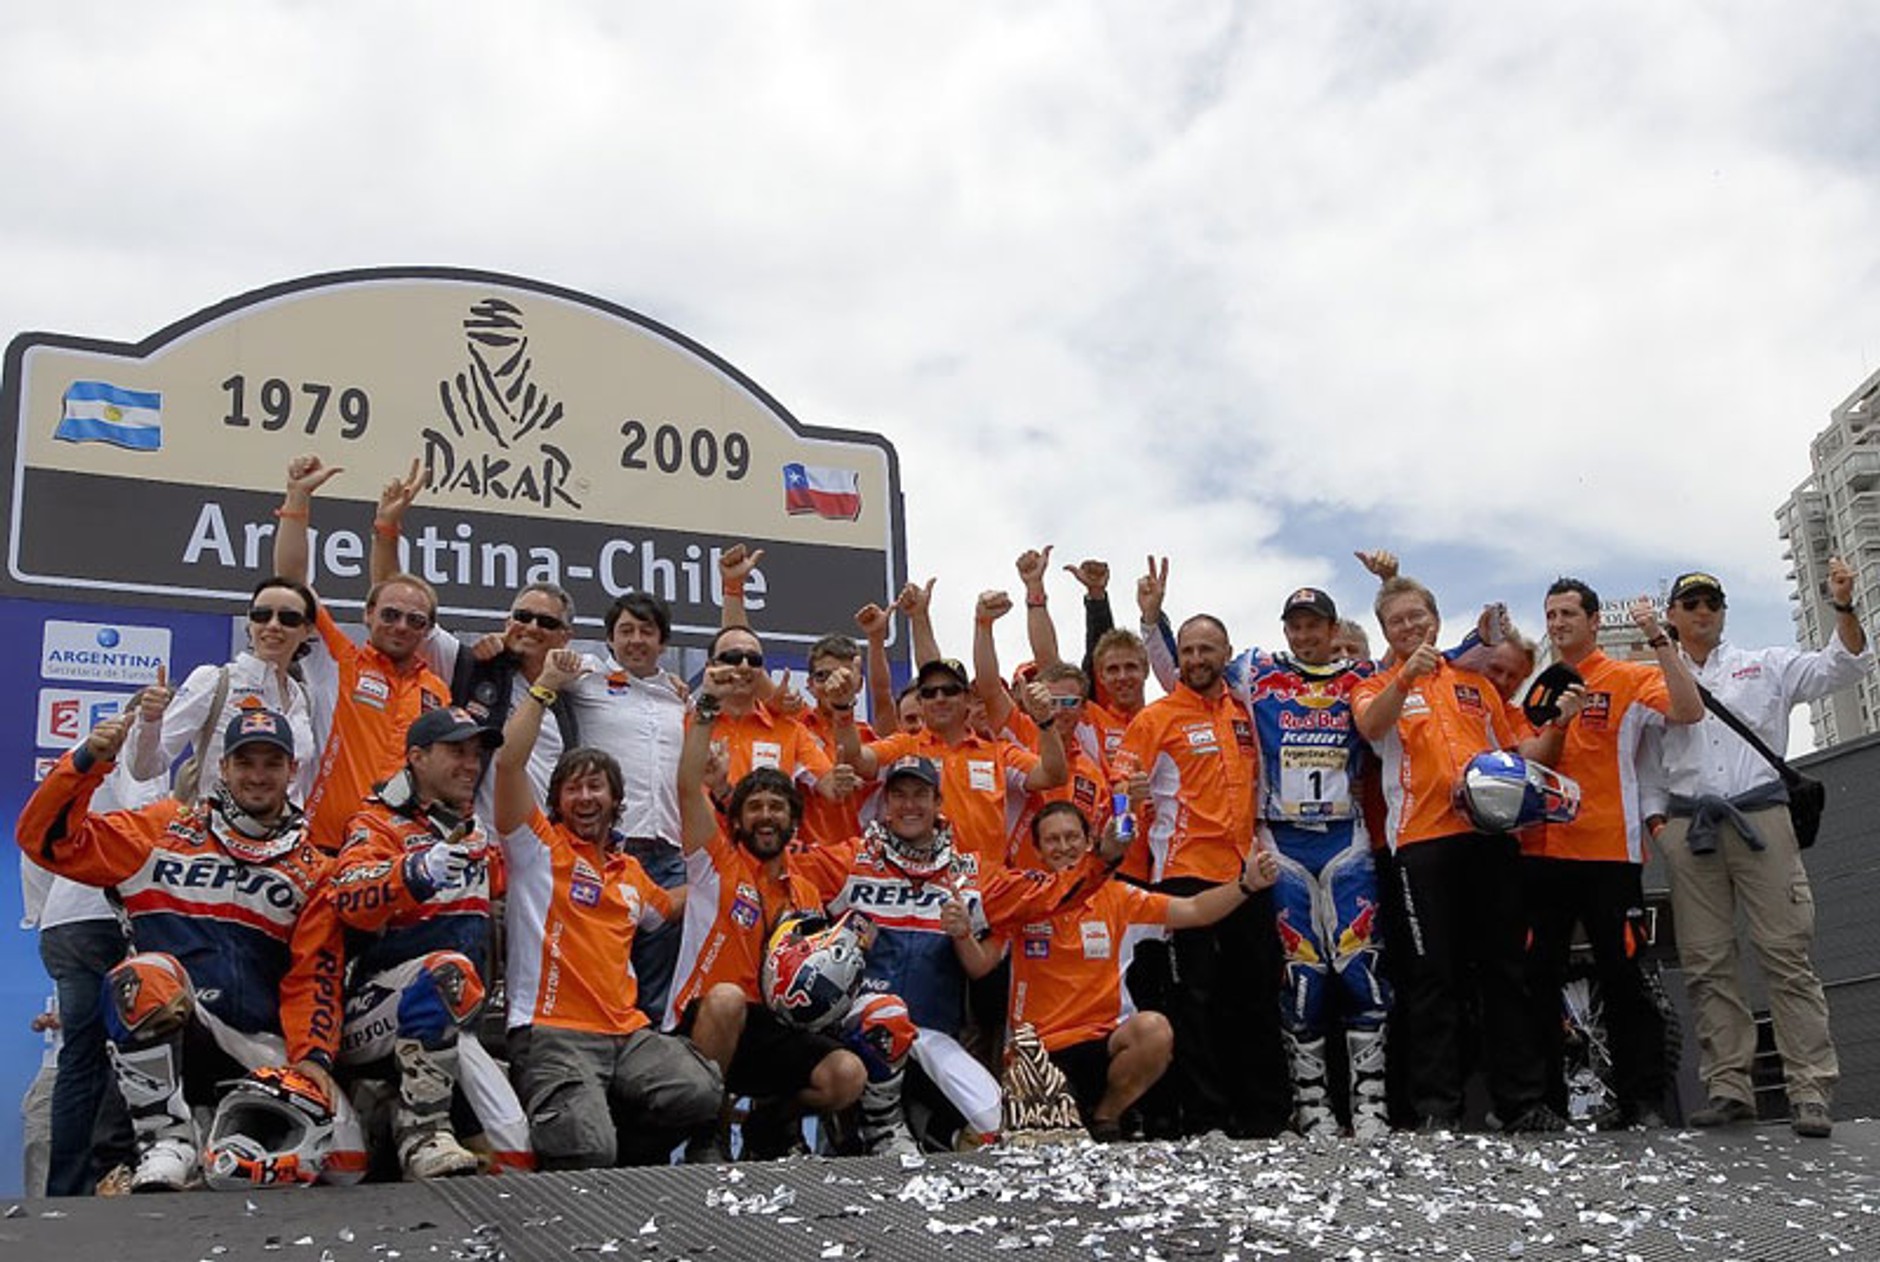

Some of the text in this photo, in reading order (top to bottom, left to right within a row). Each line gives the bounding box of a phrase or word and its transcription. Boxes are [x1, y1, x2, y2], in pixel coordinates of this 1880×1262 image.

[222, 374, 370, 440] 1979
[422, 428, 582, 510] DAKAR
[620, 420, 750, 481] 2009
[183, 502, 768, 610] Aretina-Chile
[49, 650, 163, 669] ARGENTINA
[1281, 710, 1351, 730] Red Bull
[1308, 770, 1323, 801] 1
[1008, 1092, 1082, 1128] DAKAR
